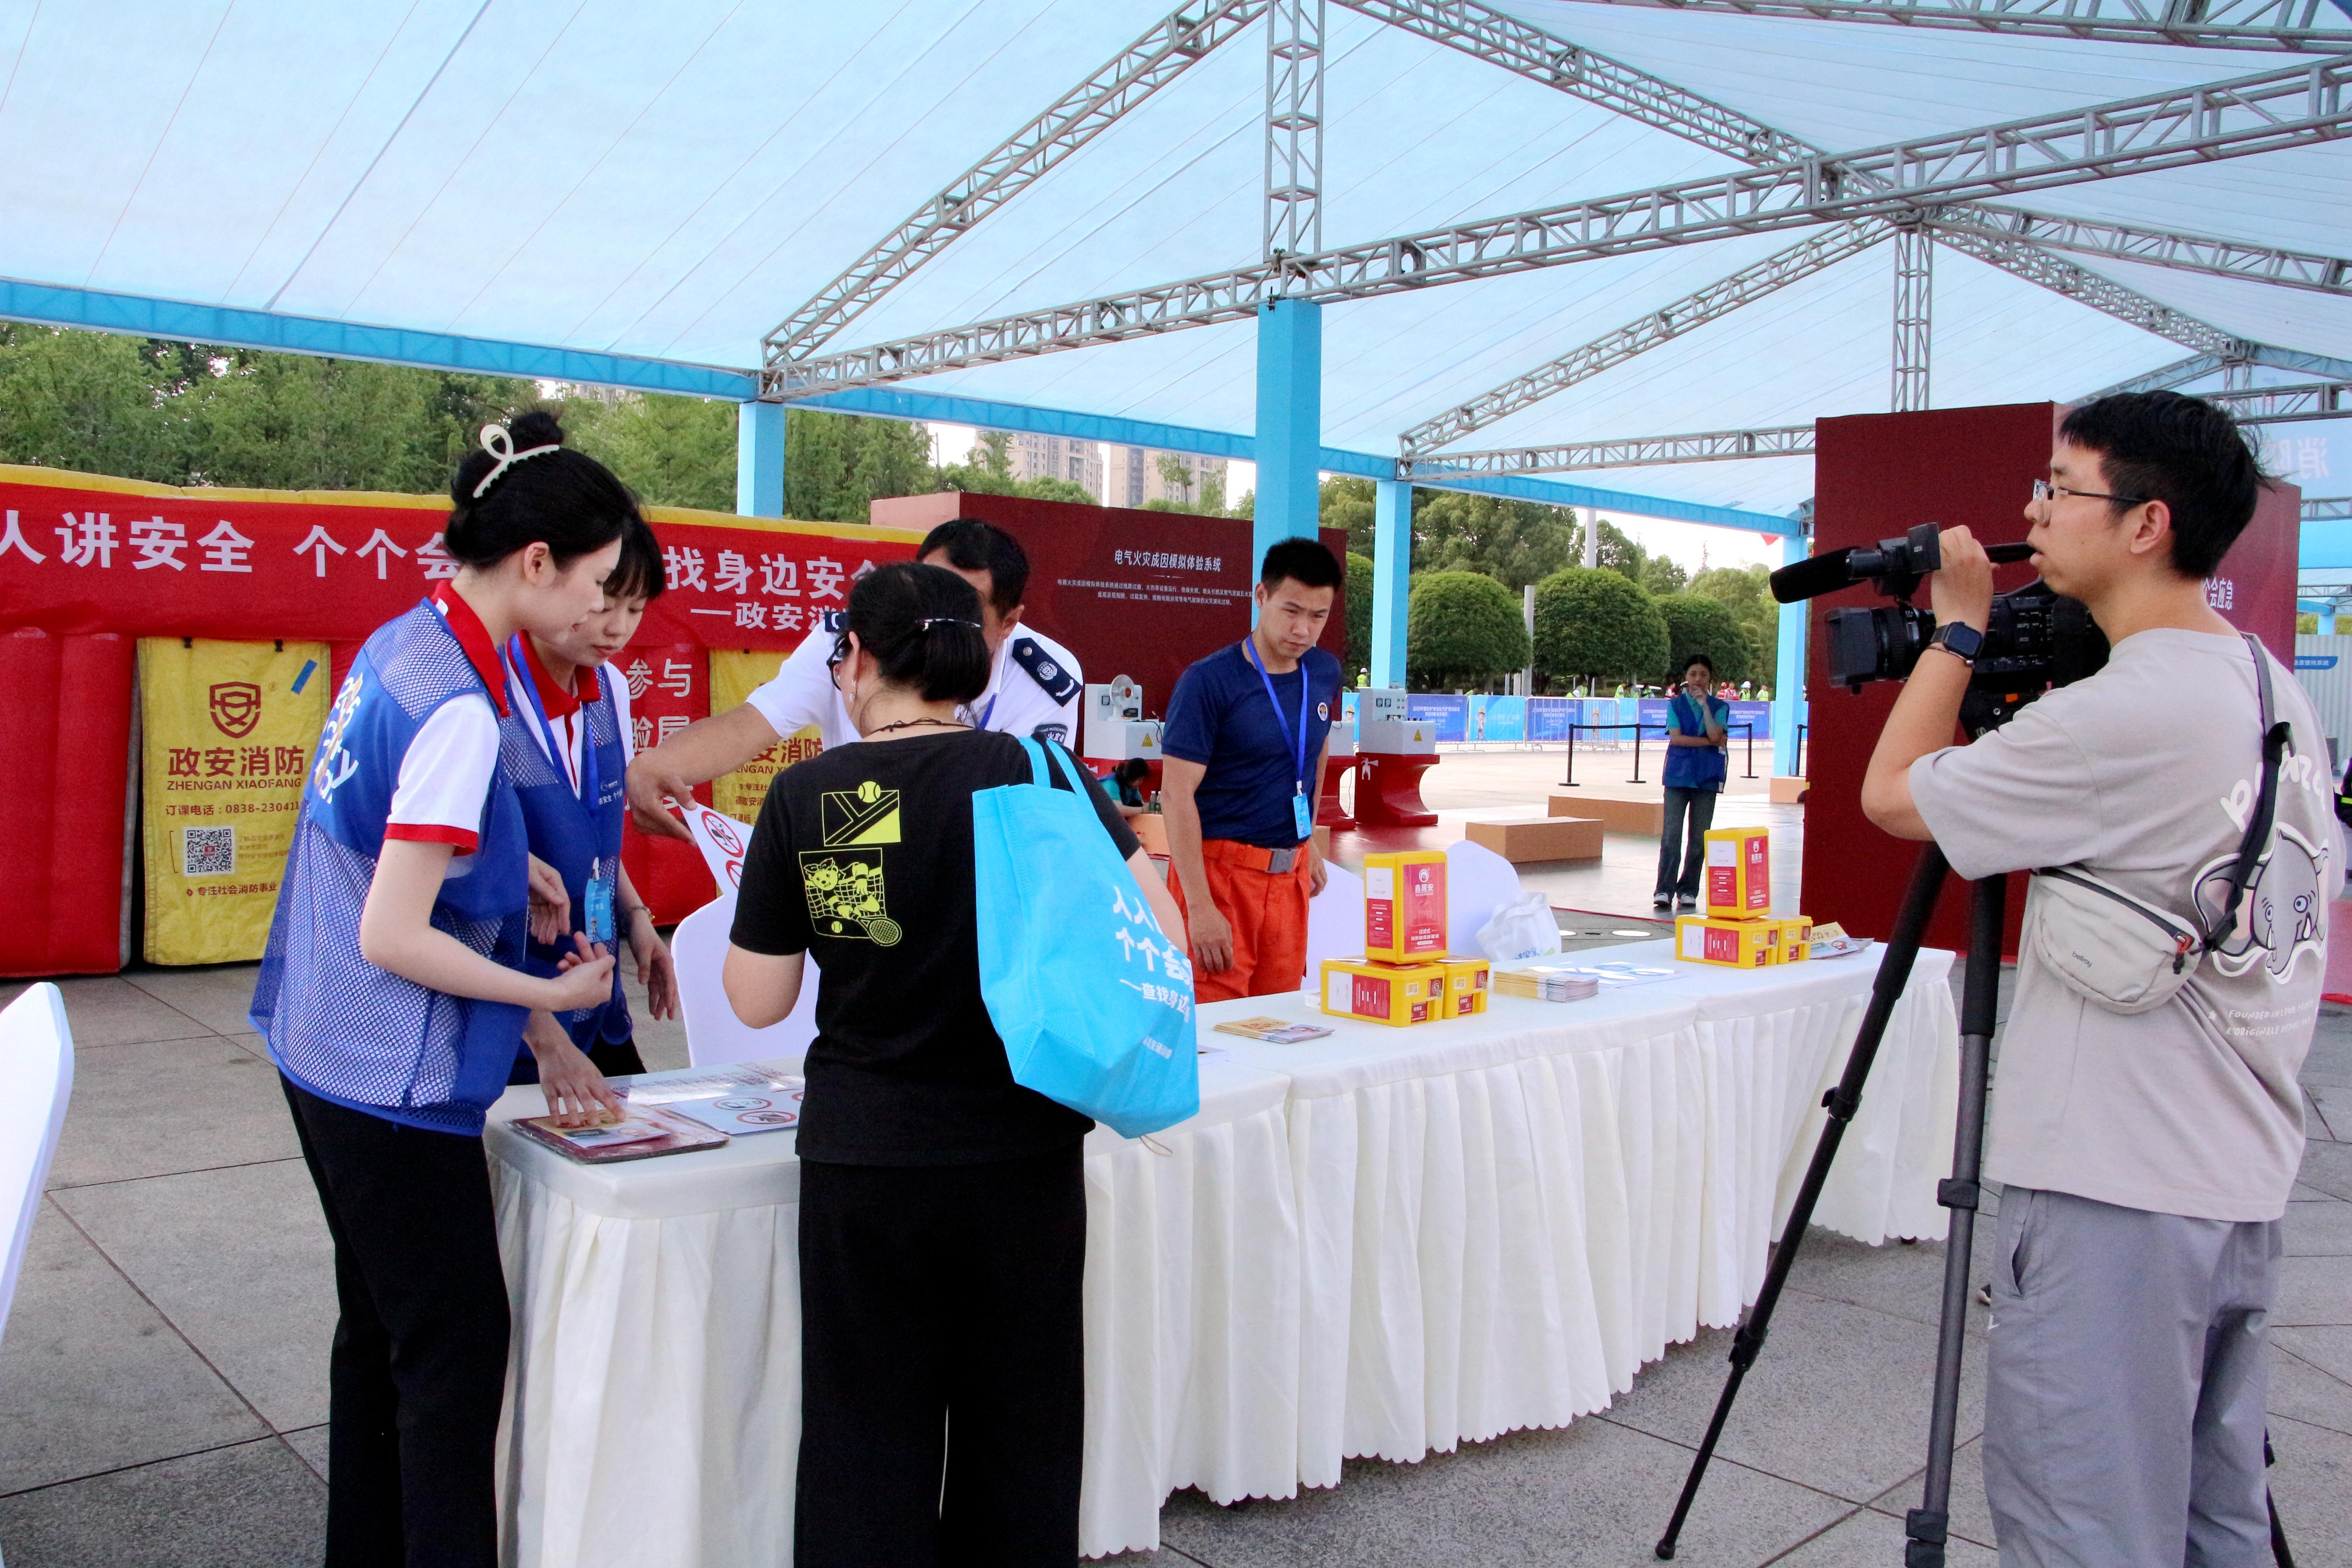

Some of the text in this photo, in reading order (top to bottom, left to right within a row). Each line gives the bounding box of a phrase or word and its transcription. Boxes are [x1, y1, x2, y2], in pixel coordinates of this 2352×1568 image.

[1114, 549, 1221, 572] 电气火灾成因模拟体验系统
[663, 546, 877, 600] 找身边安
[626, 658, 692, 700] 参与
[168, 745, 304, 777] 政安消防
[737, 765, 773, 774] NGAN
[167, 778, 302, 791] ZHENGAN XIAOFANG
[197, 882, 277, 897] 专注社会消防事业
[2072, 951, 2092, 968] bellroy
[2229, 1009, 2269, 1020] FOUNDED
